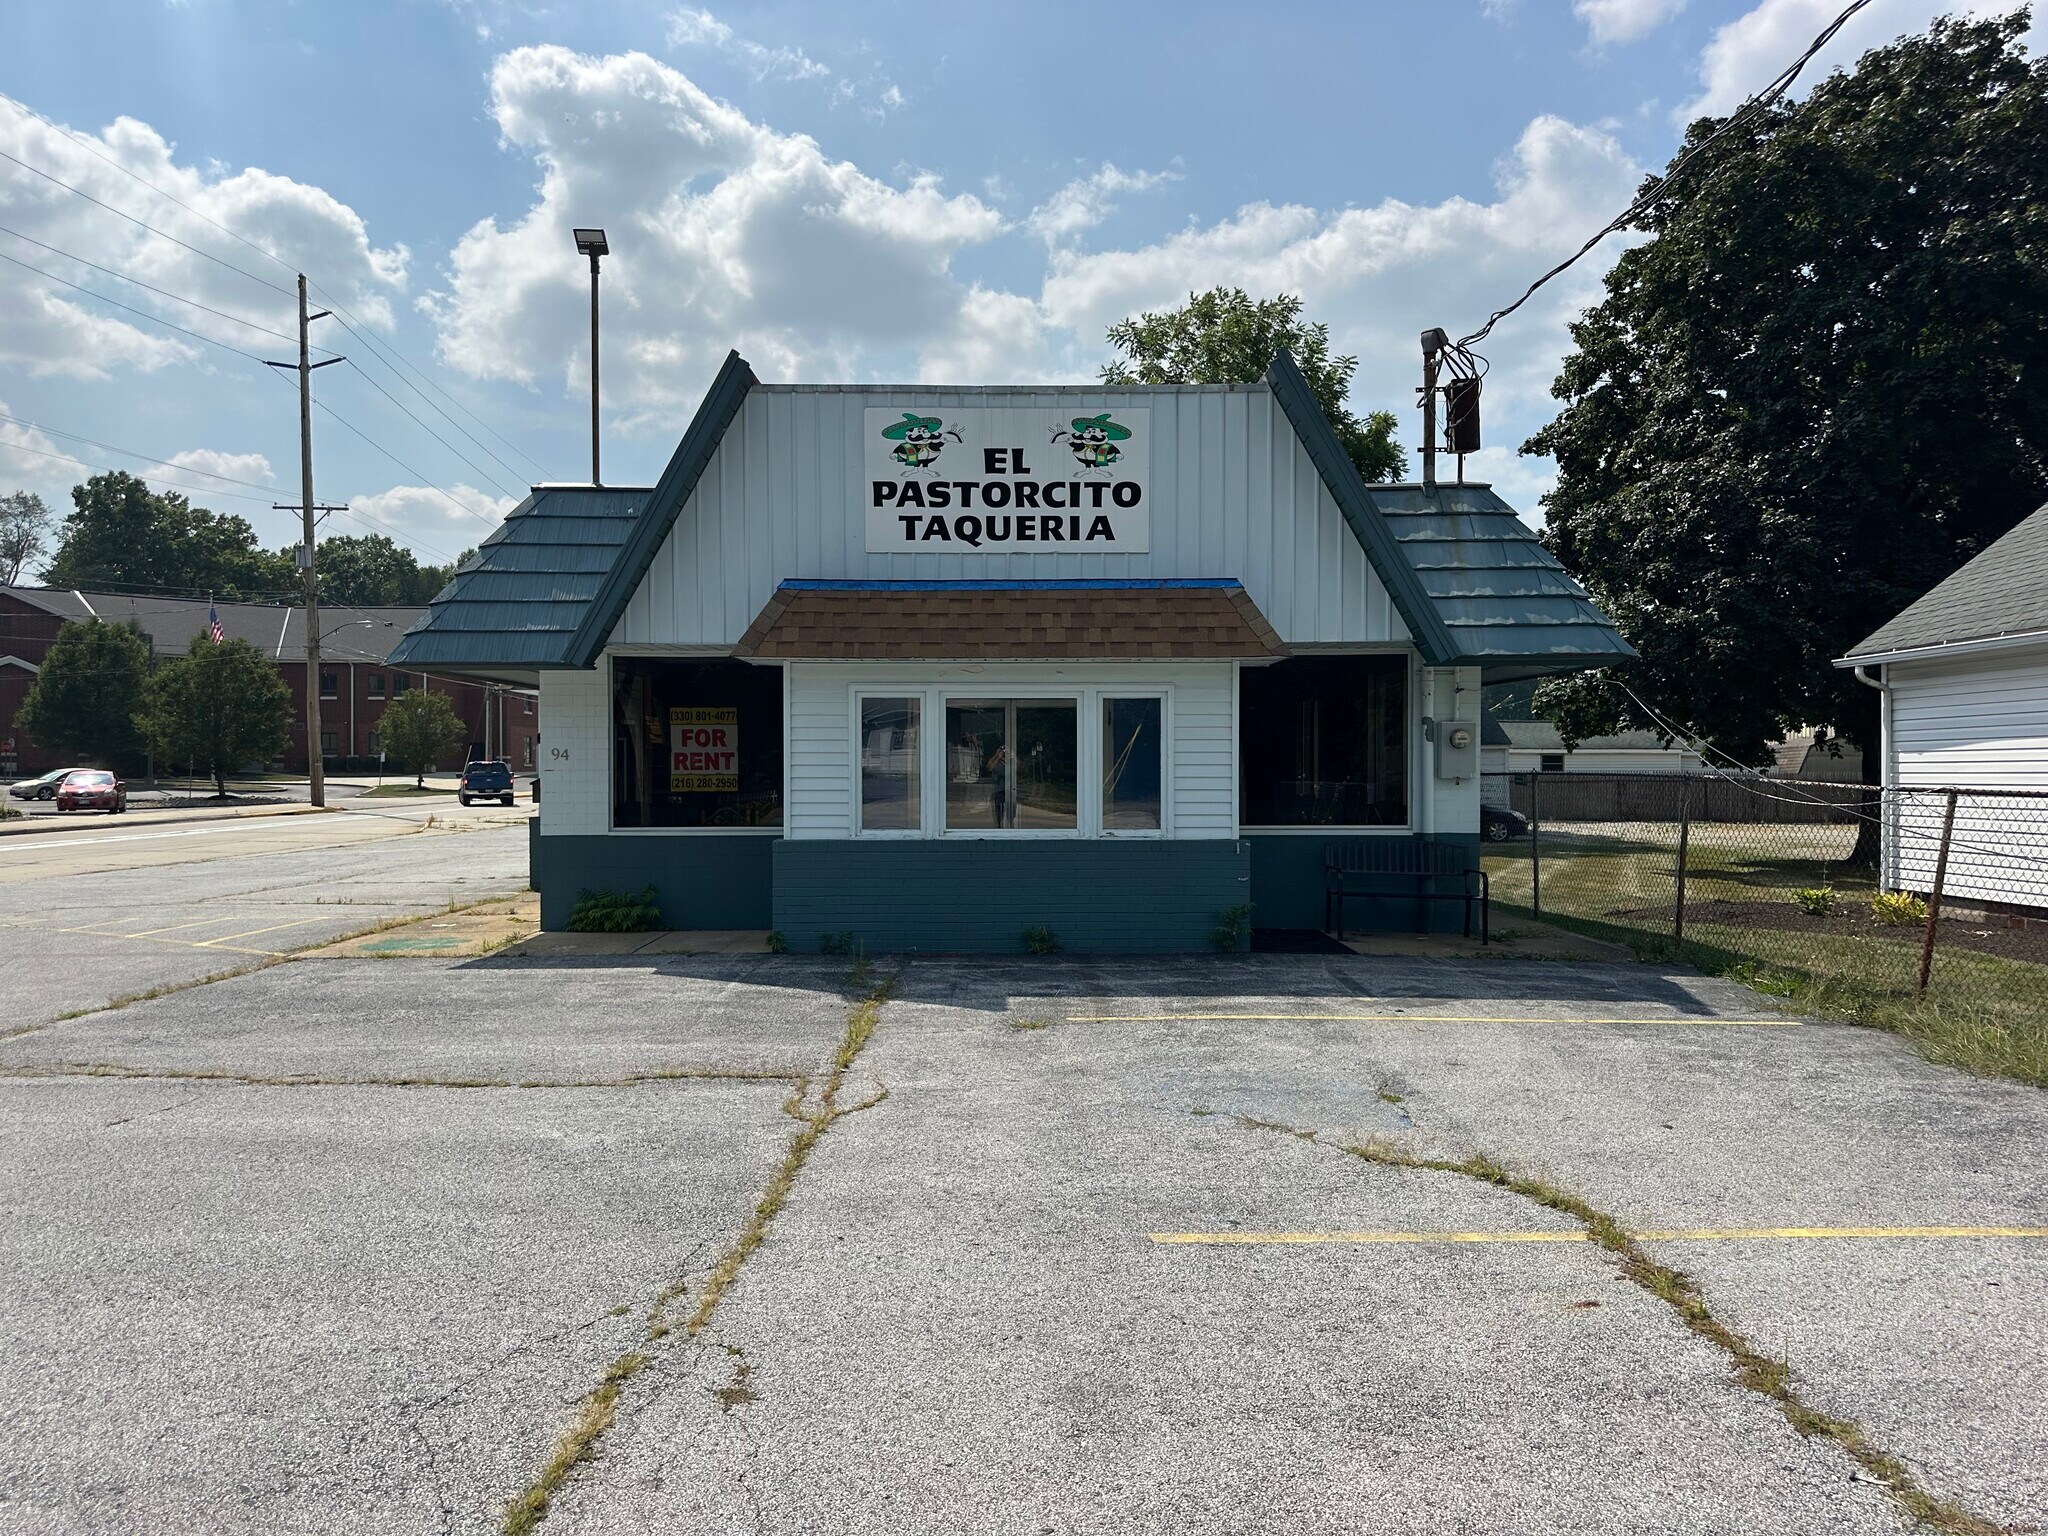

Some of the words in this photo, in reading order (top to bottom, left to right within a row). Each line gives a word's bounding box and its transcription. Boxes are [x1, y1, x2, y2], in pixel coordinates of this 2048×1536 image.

[983, 447, 1031, 475] EL
[872, 480, 1142, 509] PASTORCITO
[898, 515, 1116, 548] TAQUERIA
[670, 711, 693, 722] (330)
[695, 711, 736, 721] 801-4077
[681, 728, 727, 747] FOR
[551, 747, 570, 761] 94
[673, 751, 735, 771] RENT
[671, 778, 694, 789] (216)
[696, 778, 737, 789] 280-2950
